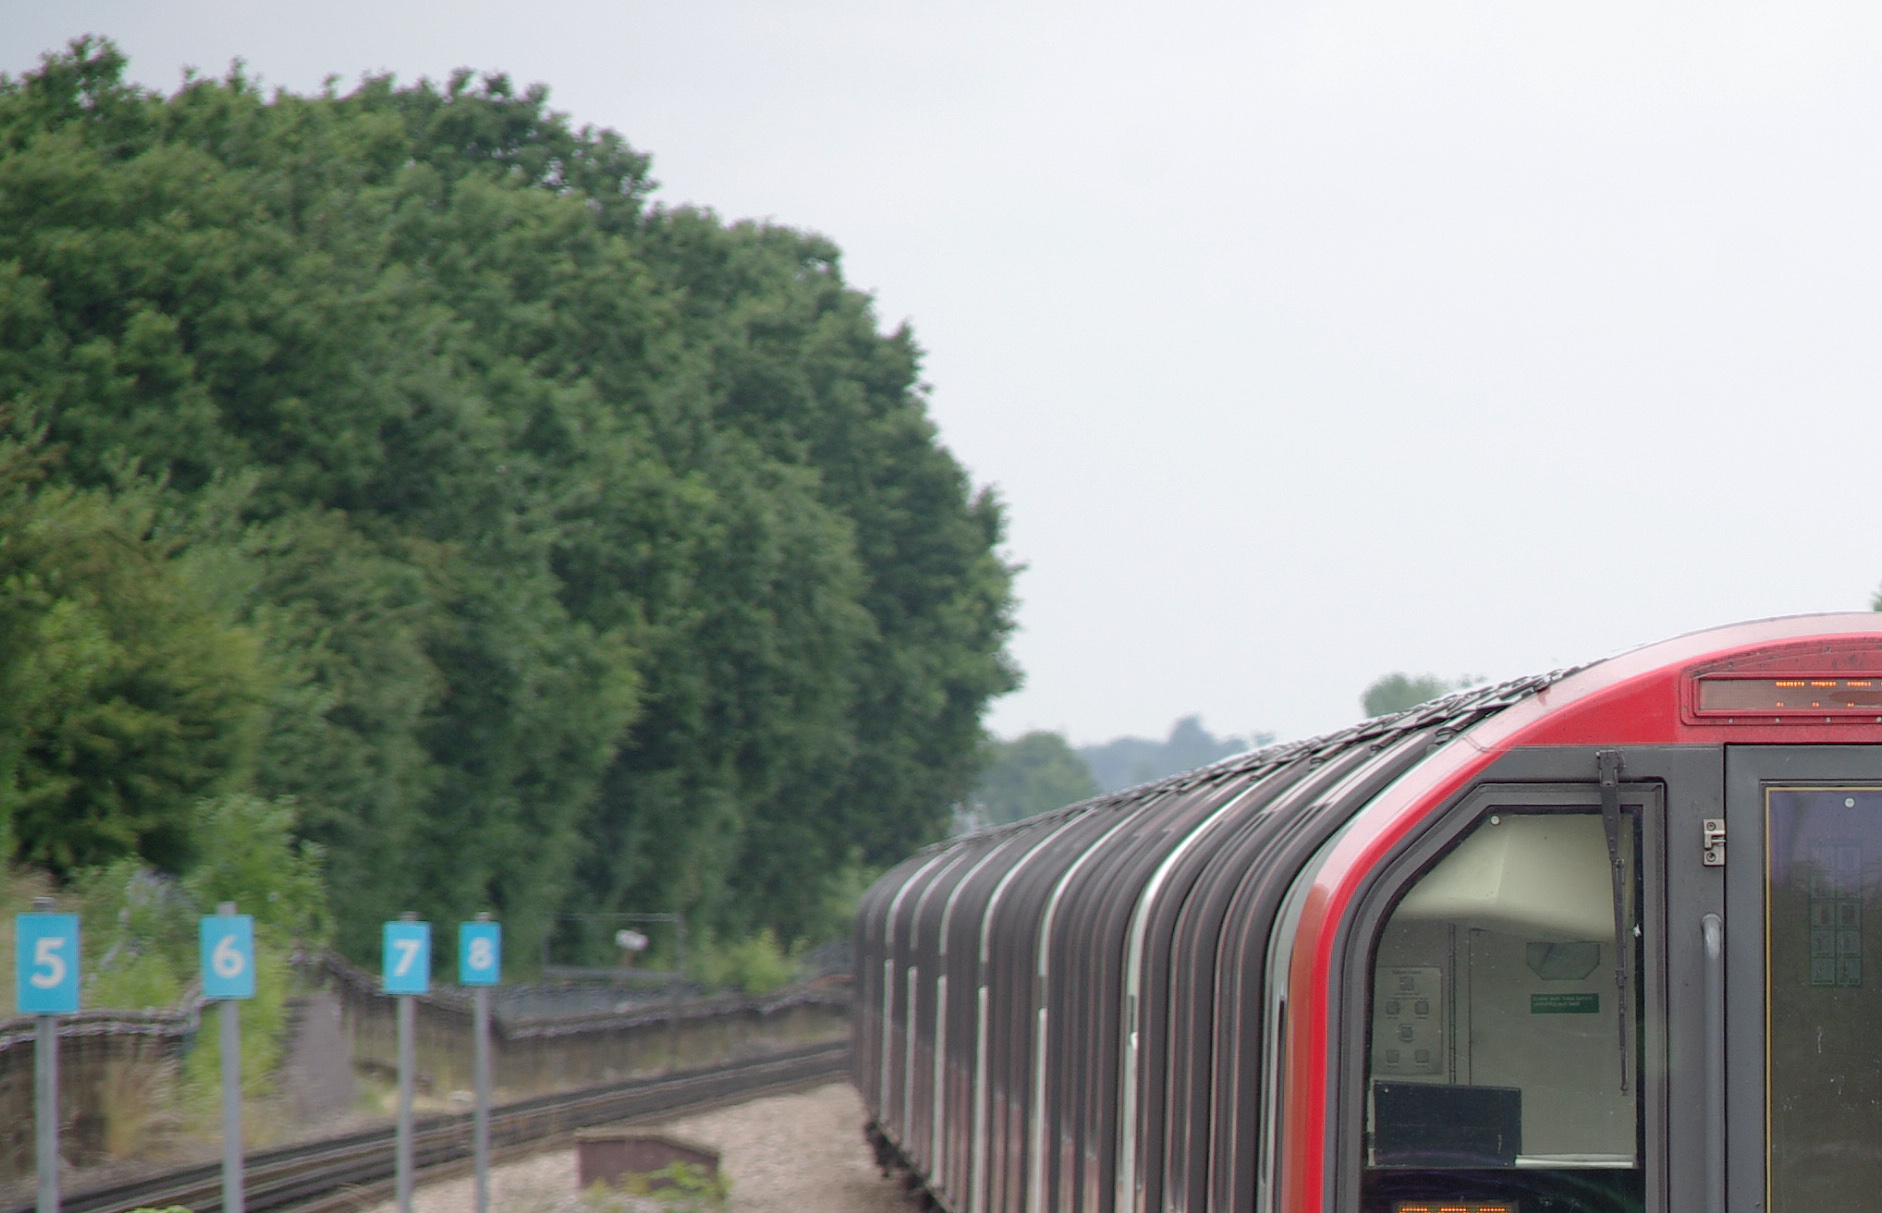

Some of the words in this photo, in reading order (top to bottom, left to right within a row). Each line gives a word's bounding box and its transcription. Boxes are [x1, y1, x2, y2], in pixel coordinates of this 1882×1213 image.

[30, 936, 67, 989] 5
[211, 934, 247, 979] 6
[393, 939, 420, 977] 7
[467, 937, 493, 971] 8
